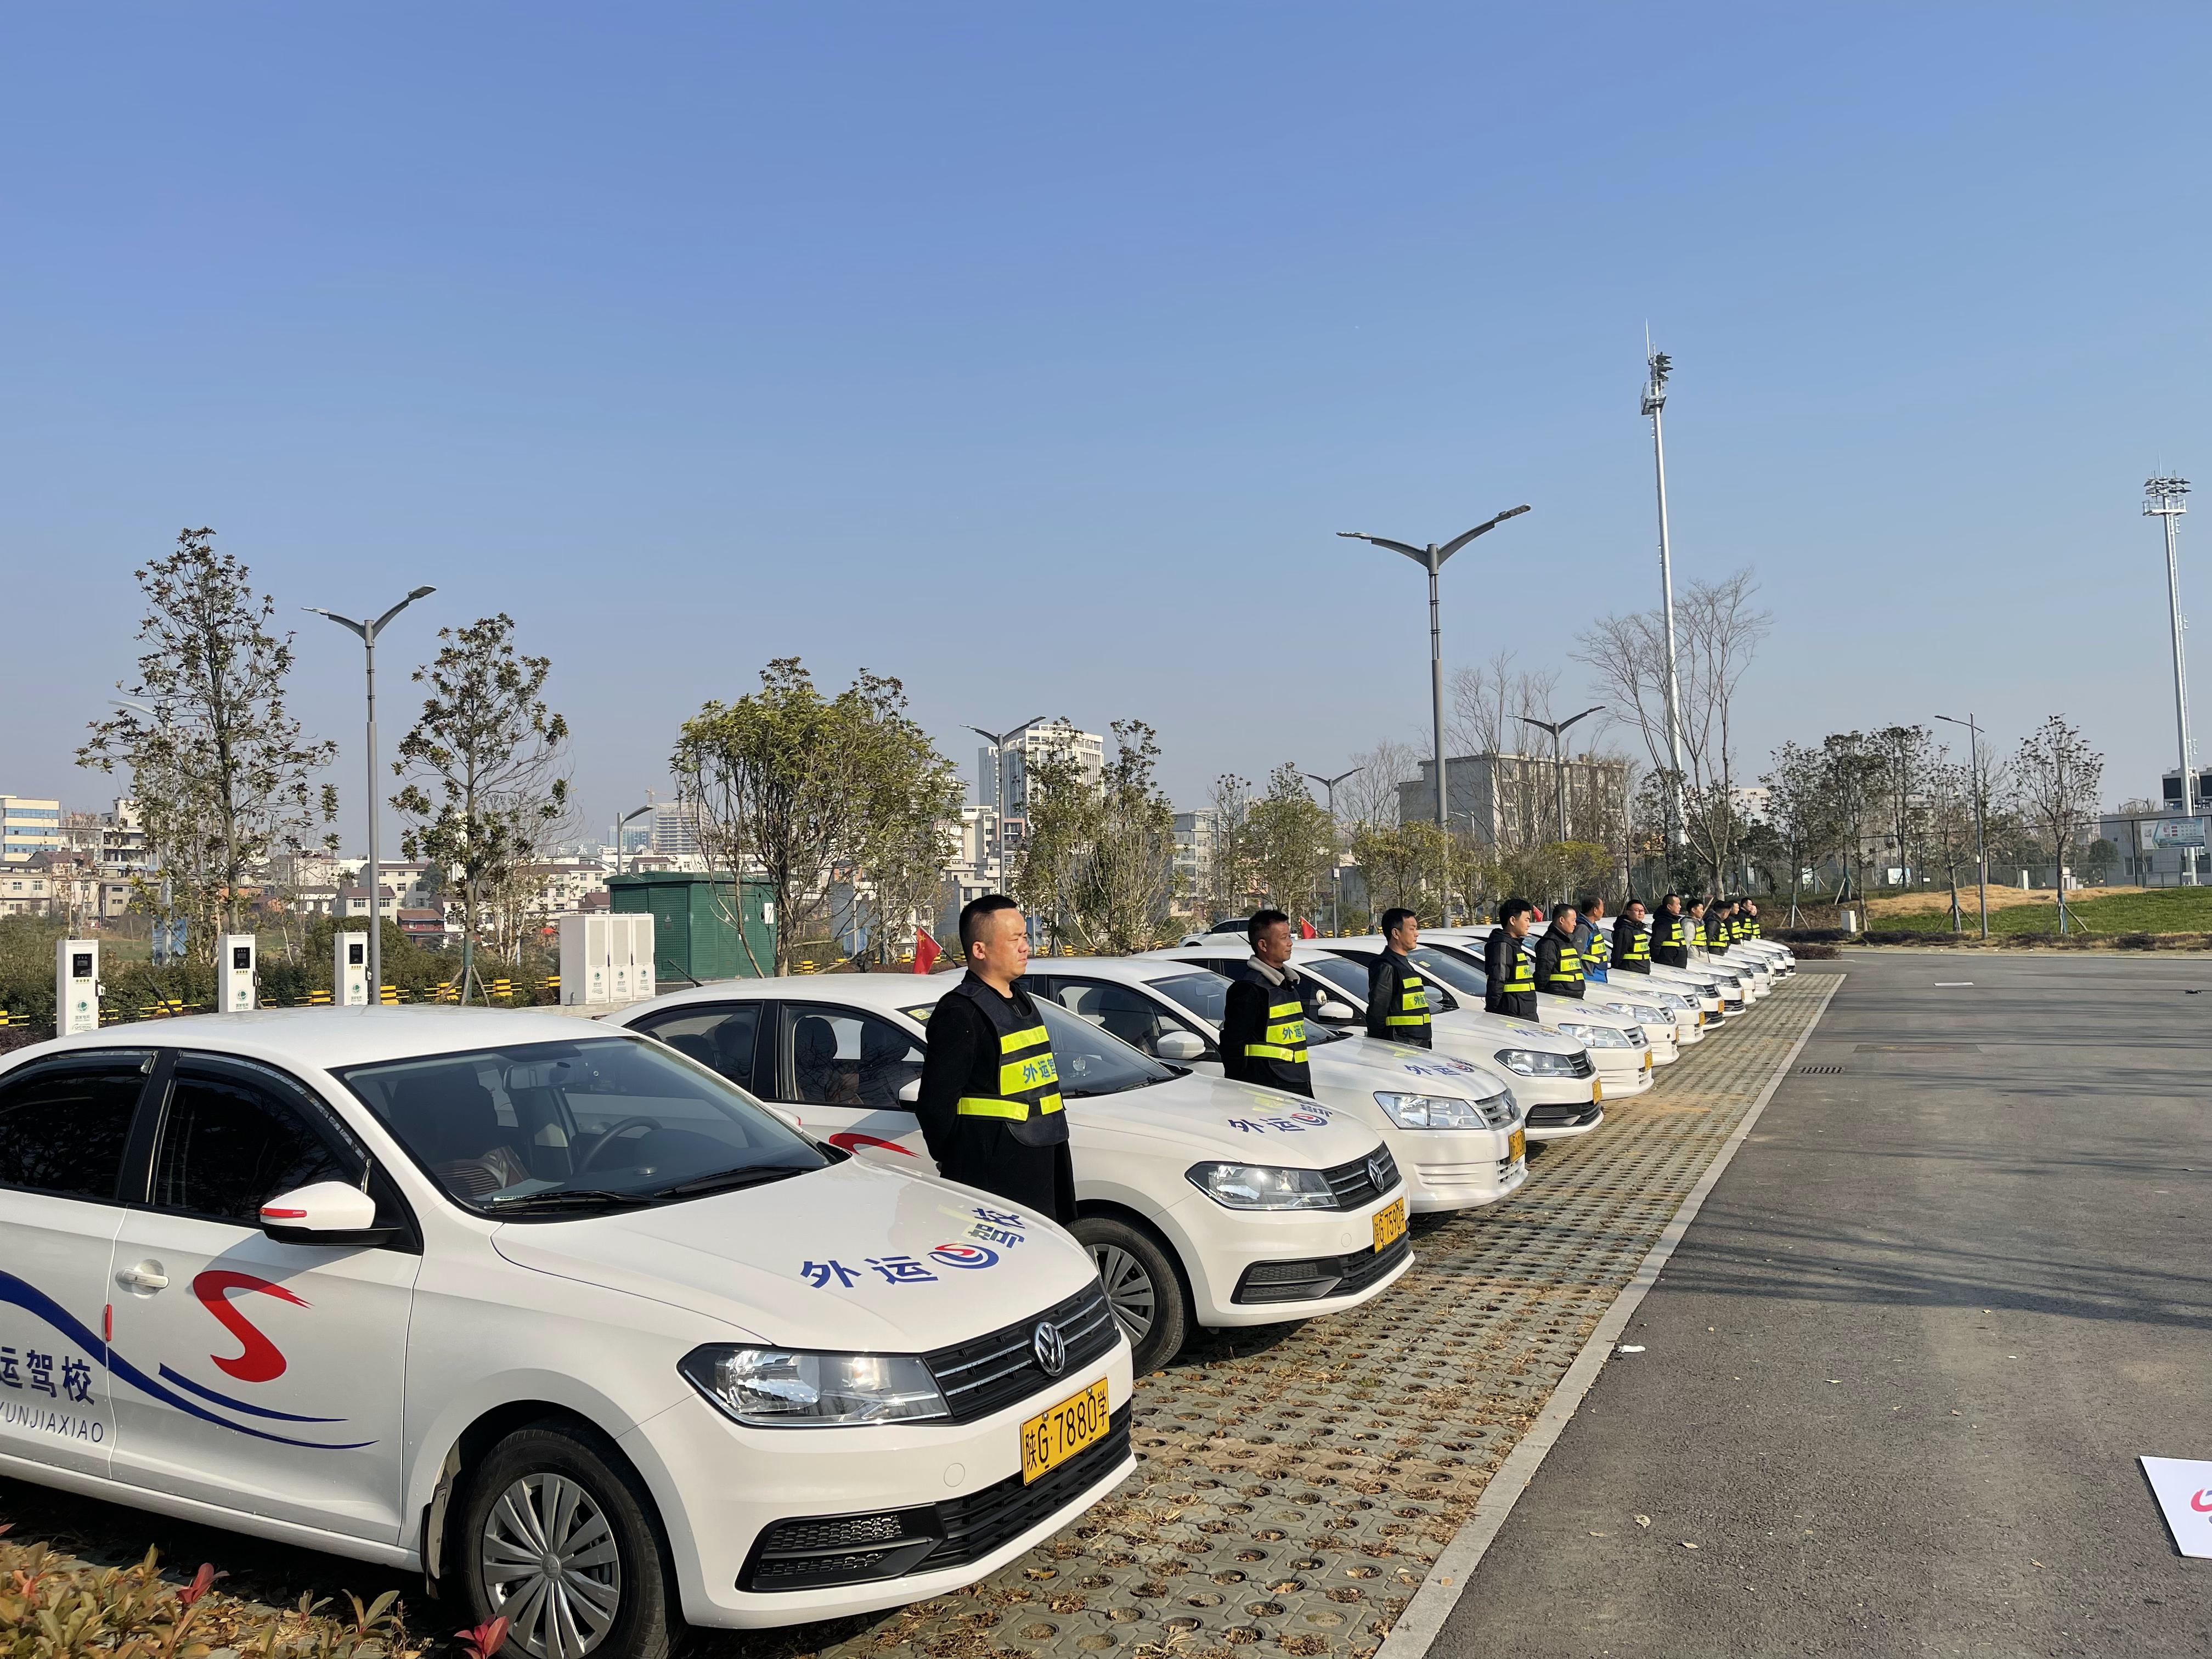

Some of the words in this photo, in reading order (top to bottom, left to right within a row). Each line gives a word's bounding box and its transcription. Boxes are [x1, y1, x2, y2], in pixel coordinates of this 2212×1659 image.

[1227, 1113, 1306, 1133] 外运
[800, 1255, 939, 1289] 外运
[967, 1207, 1026, 1249] 驾校
